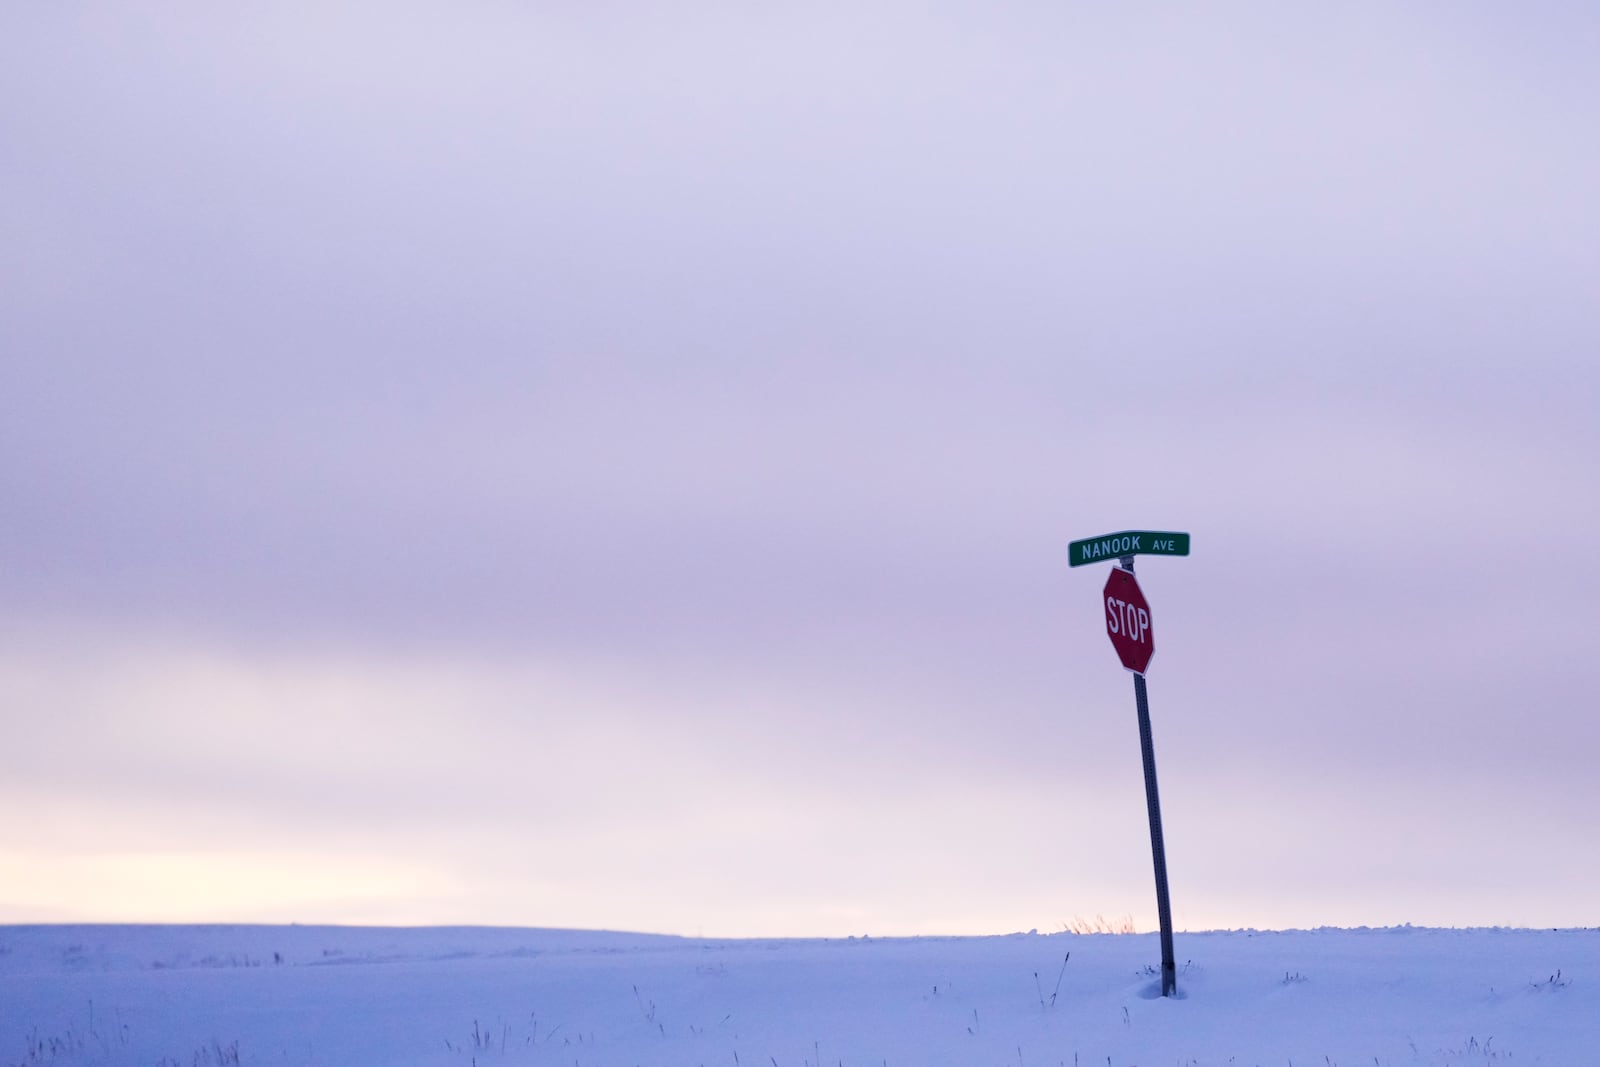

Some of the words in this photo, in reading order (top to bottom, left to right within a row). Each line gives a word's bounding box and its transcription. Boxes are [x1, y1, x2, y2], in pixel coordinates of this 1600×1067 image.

[1082, 536, 1141, 559] NANOOK
[1152, 540, 1175, 551] AVE
[1107, 596, 1149, 643] STOP
